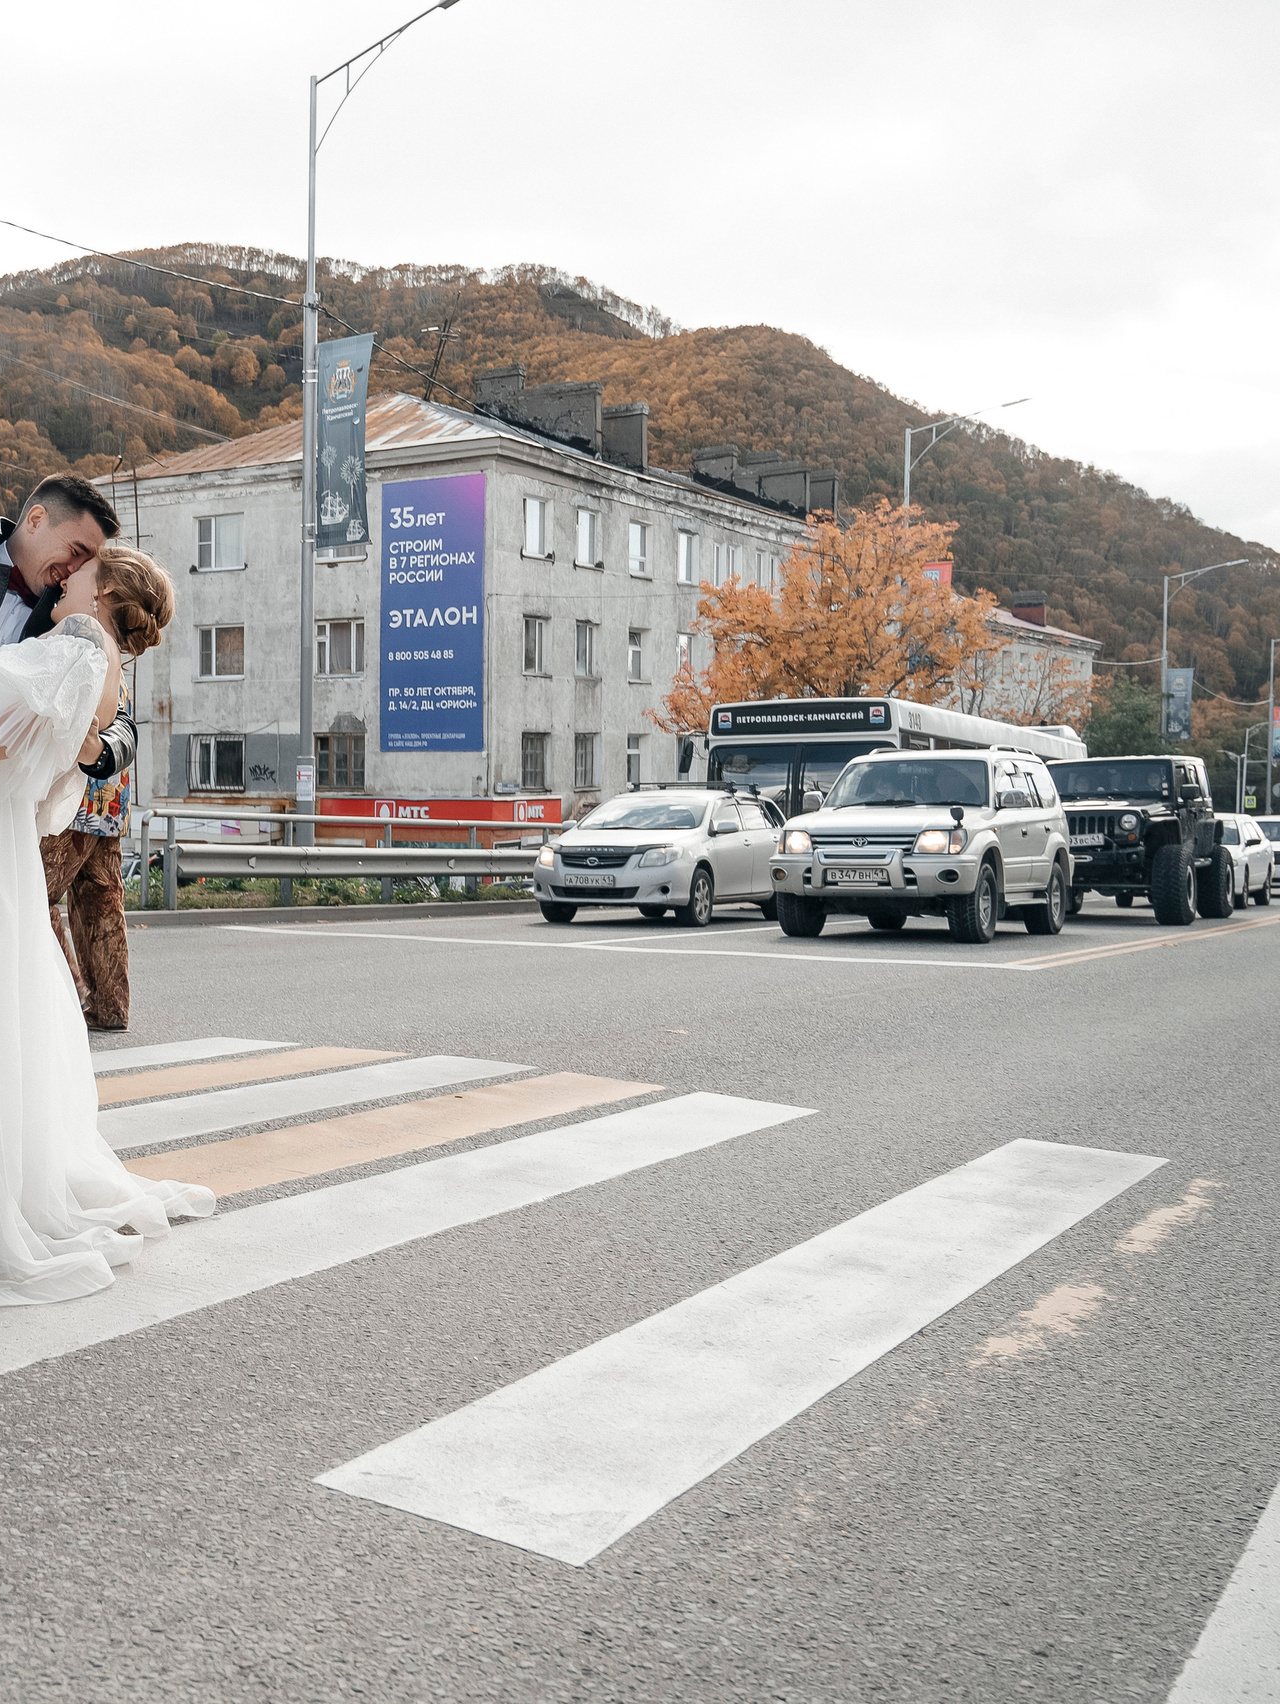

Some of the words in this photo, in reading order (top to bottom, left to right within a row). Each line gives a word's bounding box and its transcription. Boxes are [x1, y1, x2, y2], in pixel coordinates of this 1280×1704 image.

[389, 538, 443, 554] СТРОИМ
[389, 557, 397, 569] В
[400, 556, 407, 569] 7
[409, 551, 476, 568] РЕГИОНАХ
[389, 569, 443, 585] РОССИИ
[389, 605, 477, 629] ЭТАЛОН
[388, 651, 394, 661] 8
[395, 651, 412, 661] 800
[413, 650, 430, 660] 505
[430, 650, 442, 660] 48
[443, 649, 454, 659] 85
[388, 687, 403, 697] ПР.
[404, 687, 415, 697] 50
[416, 687, 433, 697] ЛЕТ
[433, 685, 476, 697] ОКТЯБРЯ,
[421, 700, 435, 711] ДЦ
[436, 699, 477, 710] «ОРИОН»
[398, 806, 430, 819] МТС
[527, 805, 545, 819] МТС
